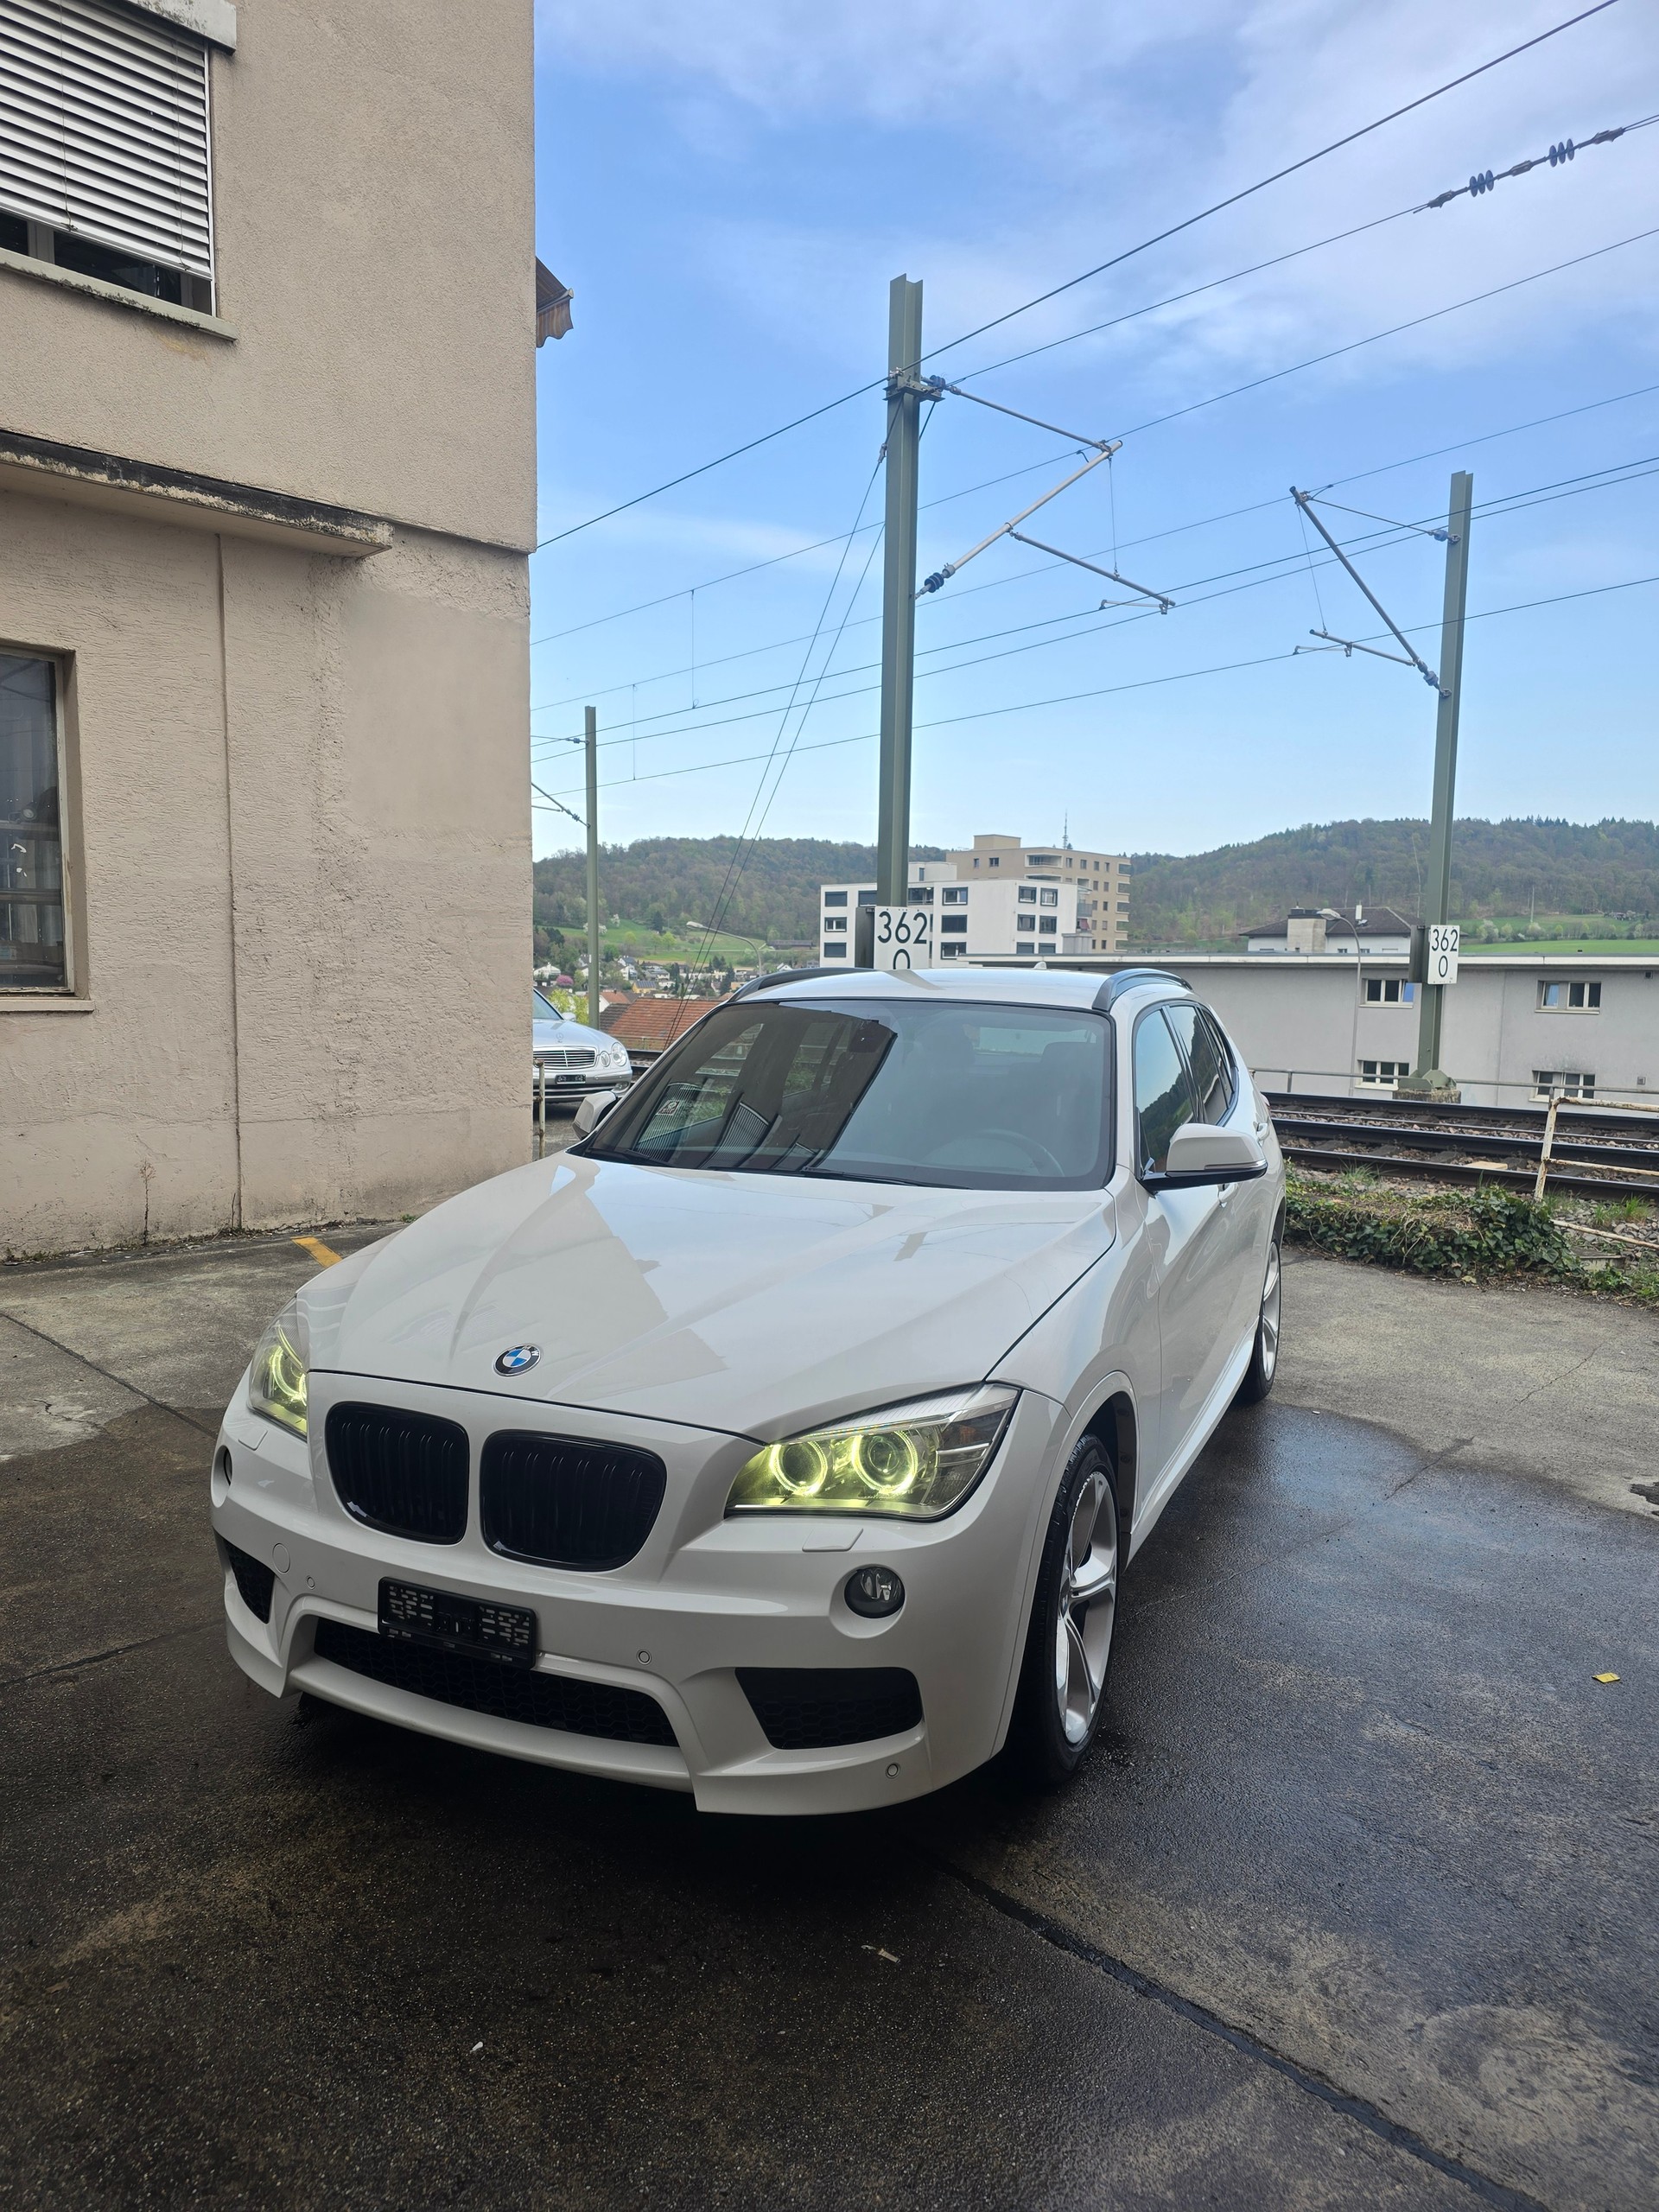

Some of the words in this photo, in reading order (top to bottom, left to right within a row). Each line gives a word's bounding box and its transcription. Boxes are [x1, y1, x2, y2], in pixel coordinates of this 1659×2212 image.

[877, 911, 927, 944] 362
[1432, 928, 1459, 951] 362
[1438, 955, 1448, 977] 0
